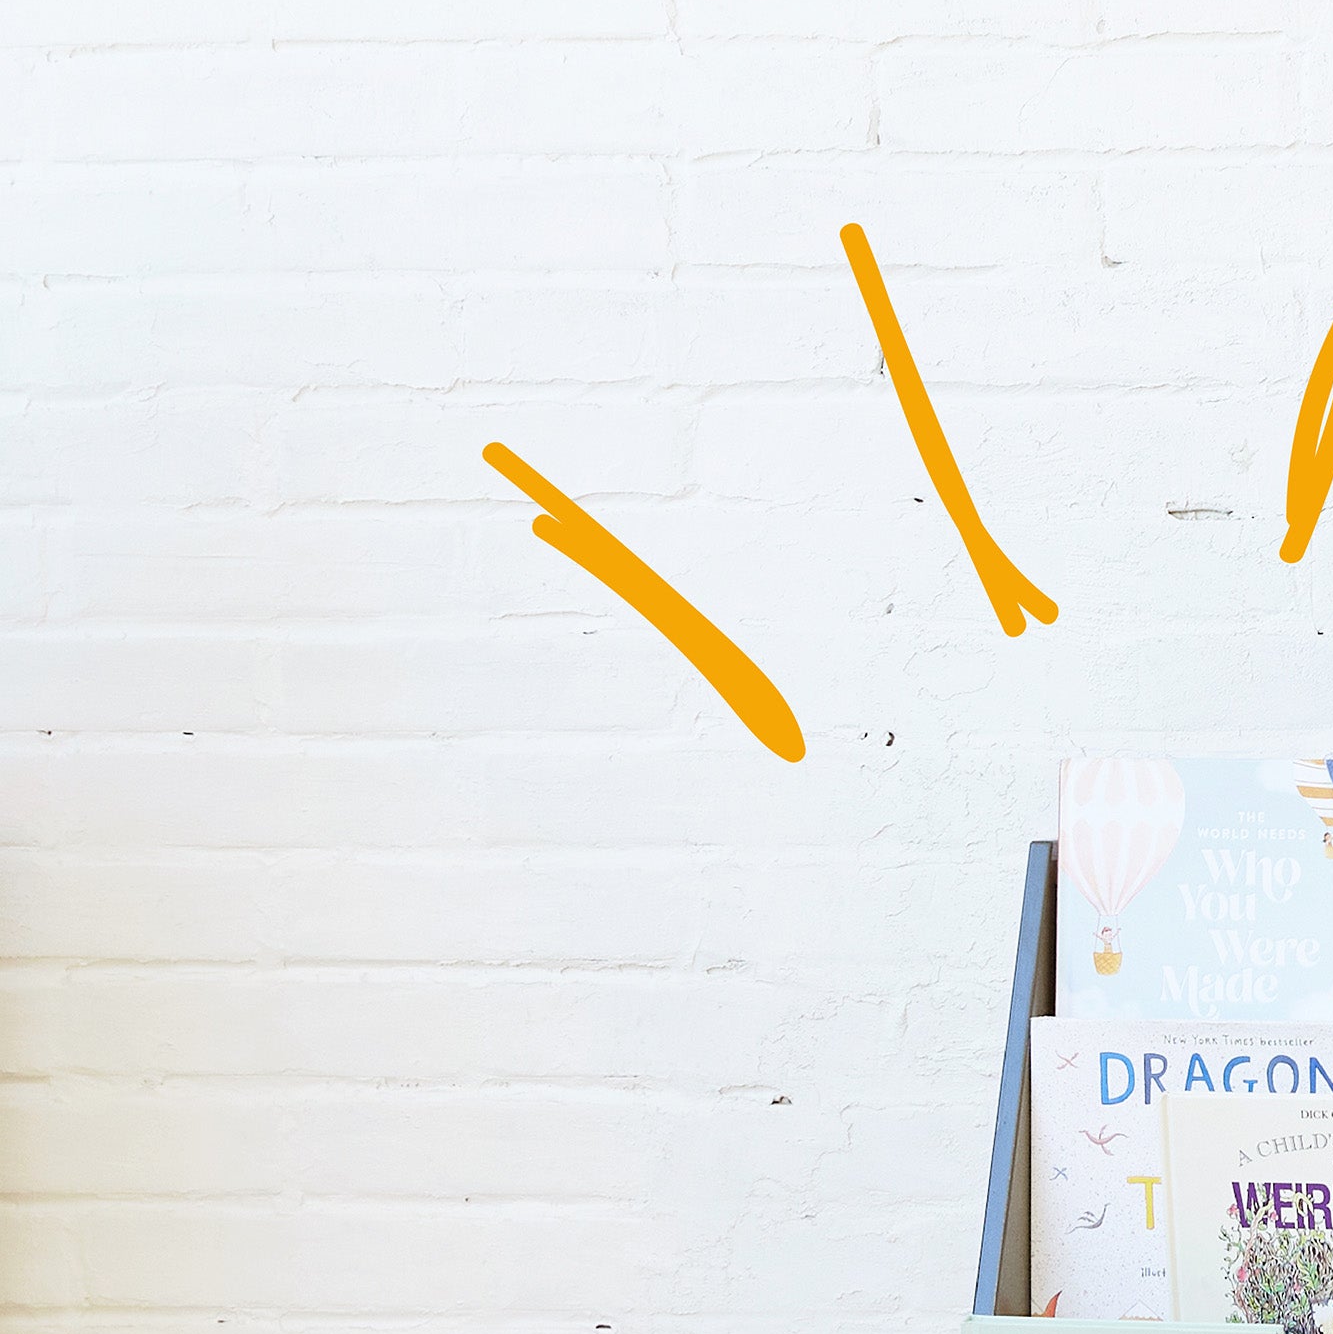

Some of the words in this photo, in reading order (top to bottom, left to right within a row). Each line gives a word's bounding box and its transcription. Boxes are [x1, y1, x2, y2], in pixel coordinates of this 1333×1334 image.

[1238, 811, 1265, 823] THE
[1198, 828, 1249, 840] WORLD
[1258, 828, 1306, 840] NEEDS
[1201, 849, 1300, 903] Who
[1177, 883, 1257, 922] You
[1208, 929, 1321, 967] Were
[1160, 965, 1279, 1019] Made
[1260, 1037, 1315, 1047] bestseller
[1300, 1109, 1328, 1120] DICK
[1238, 1150, 1253, 1168] A
